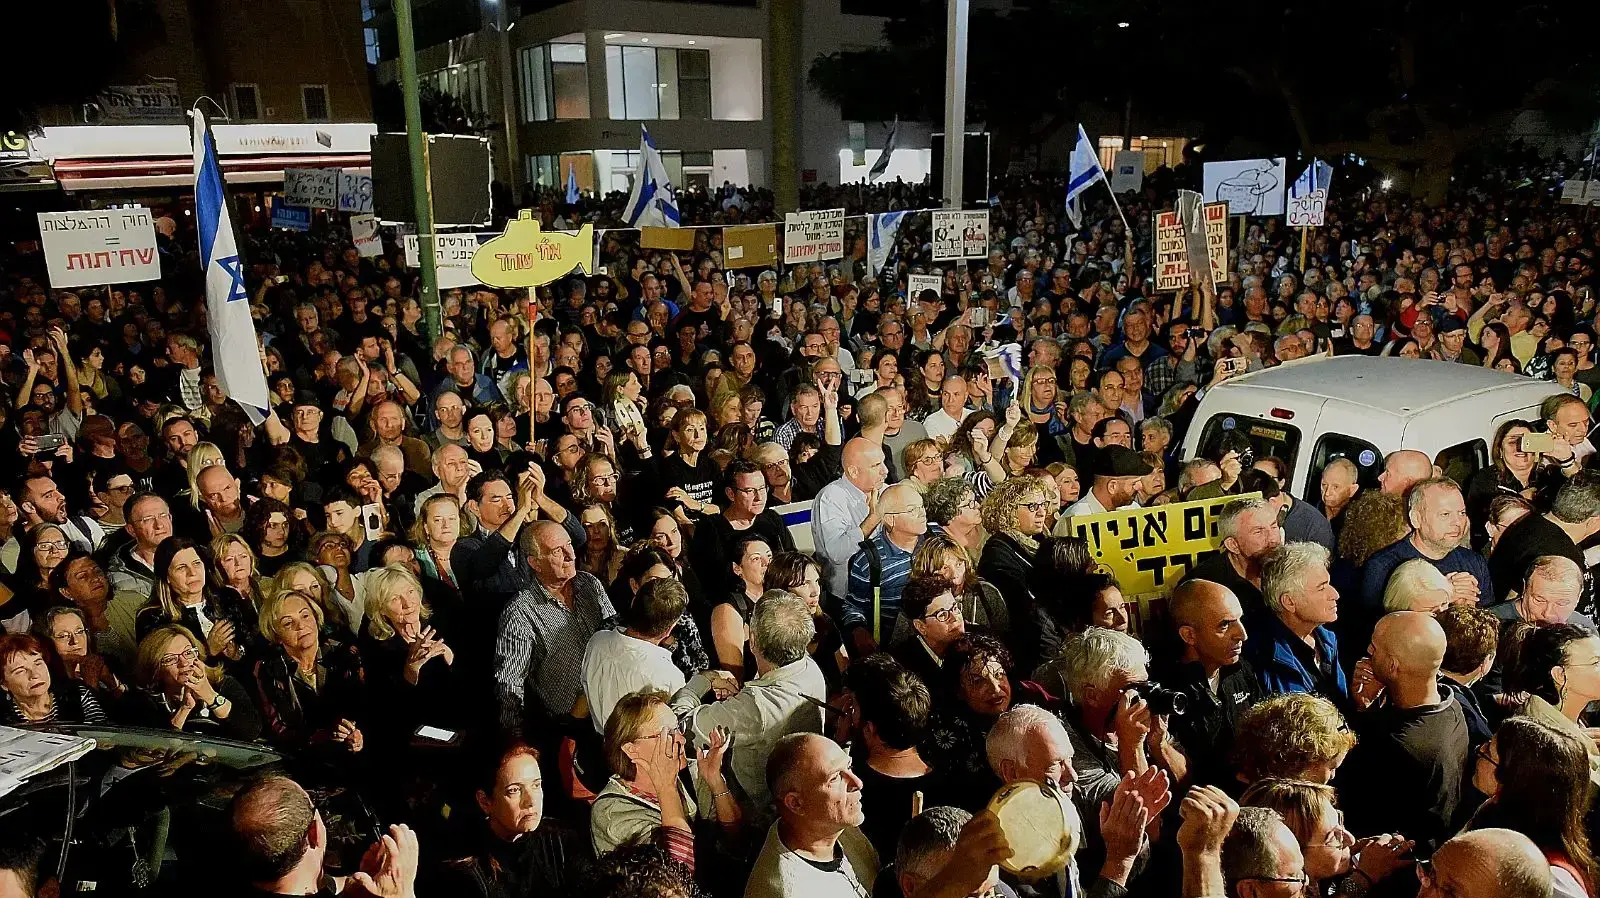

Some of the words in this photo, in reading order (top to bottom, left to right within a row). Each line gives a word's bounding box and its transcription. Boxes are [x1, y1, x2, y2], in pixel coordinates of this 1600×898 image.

[43, 216, 110, 231] ההמלצות
[122, 214, 148, 230] חוק
[438, 237, 474, 248] דורשים
[67, 247, 154, 270] שחיתות
[494, 252, 534, 271] שוחד
